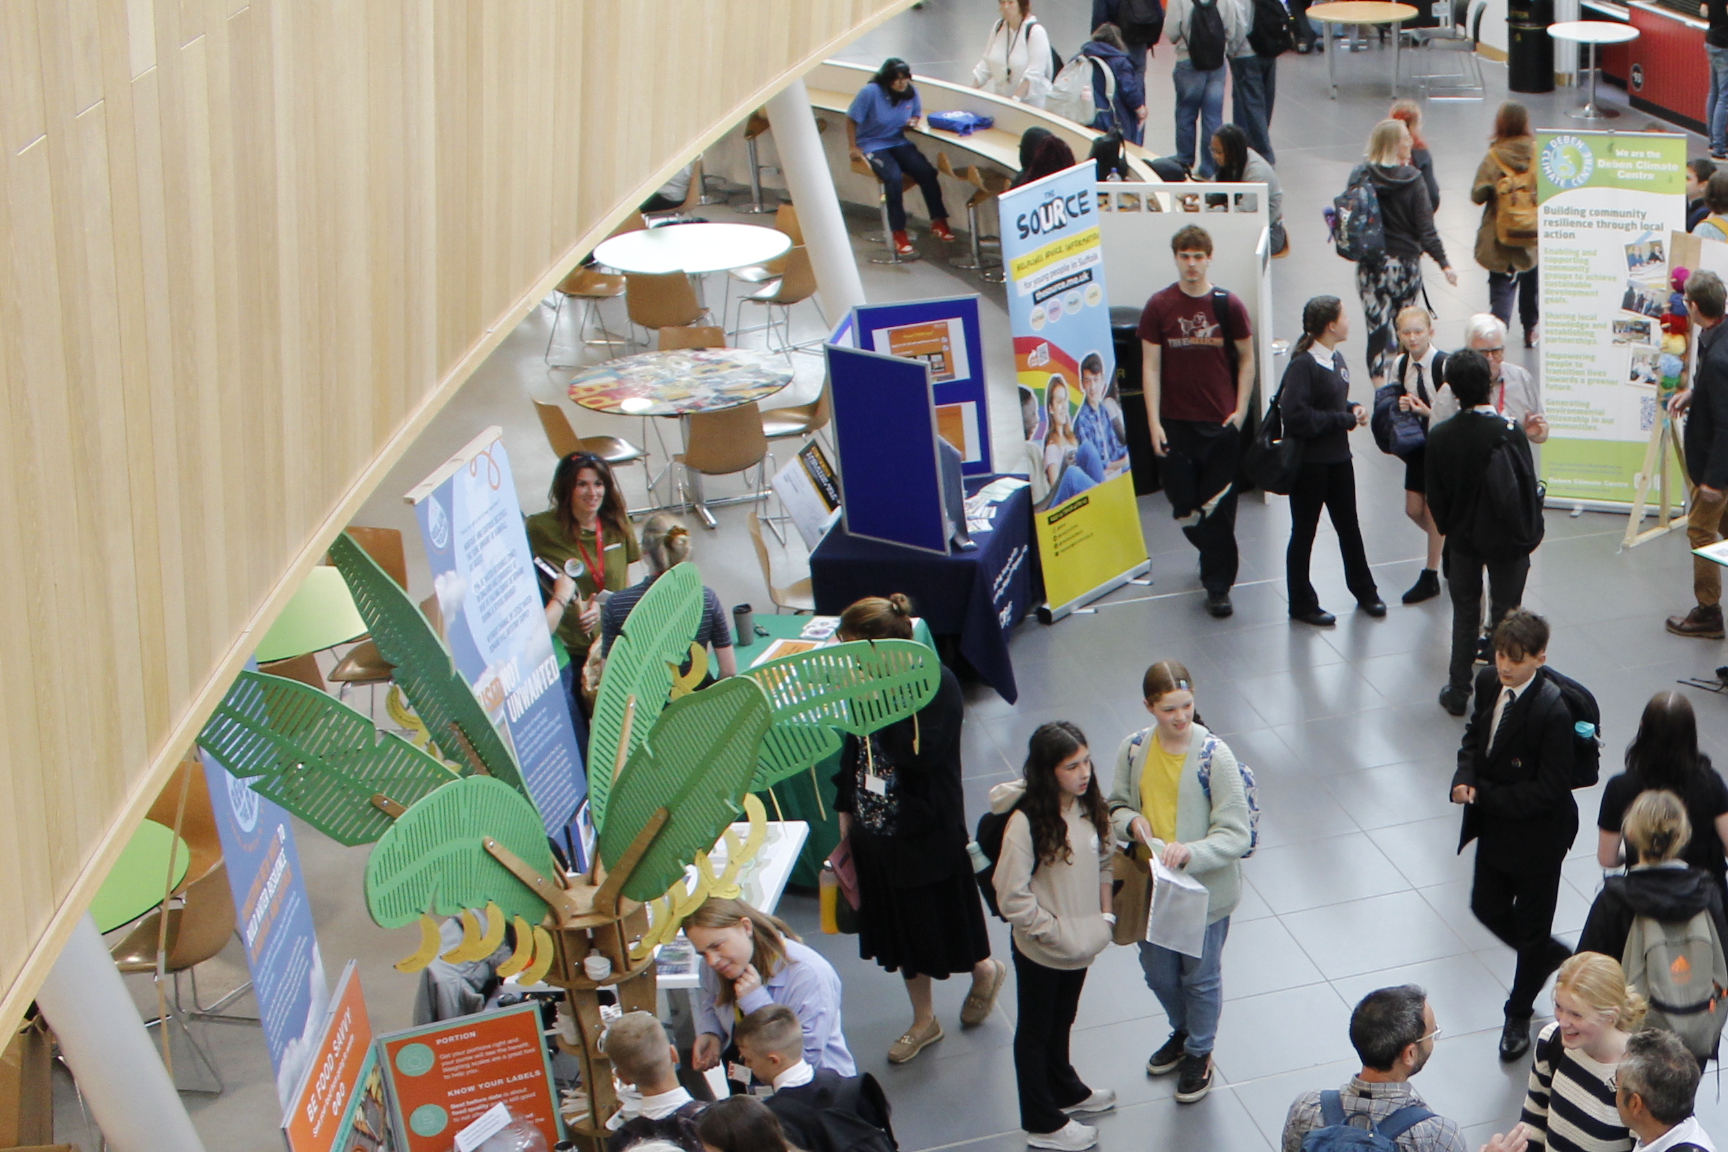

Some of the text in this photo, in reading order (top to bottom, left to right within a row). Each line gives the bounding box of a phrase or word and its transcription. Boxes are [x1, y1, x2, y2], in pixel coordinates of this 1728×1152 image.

[1550, 136, 1585, 149] DEBEN
[1615, 149, 1661, 159] We are the
[1541, 150, 1566, 187] CLIMATE
[1571, 152, 1593, 186] CENTRE
[1598, 159, 1679, 172] Deben Climate
[1617, 170, 1655, 180] Centre
[1017, 189, 1092, 240] SOURCE
[1543, 206, 1647, 220] Building community
[1543, 218, 1664, 231] resilience through local
[1543, 230, 1576, 239] action
[1544, 248, 1597, 258] Enabling and
[1586, 274, 1617, 282] achieve
[1545, 312, 1597, 322] Sharing local
[1546, 398, 1590, 409] Generating
[499, 655, 521, 695] NOT
[506, 654, 561, 724] UNWANTED
[436, 1031, 476, 1046] PORTION
[306, 1092, 318, 1123] BE
[315, 1052, 335, 1101] FOOD
[332, 1006, 352, 1058] SAVVY
[447, 1069, 542, 1098] KNOW YOUR LABELS
